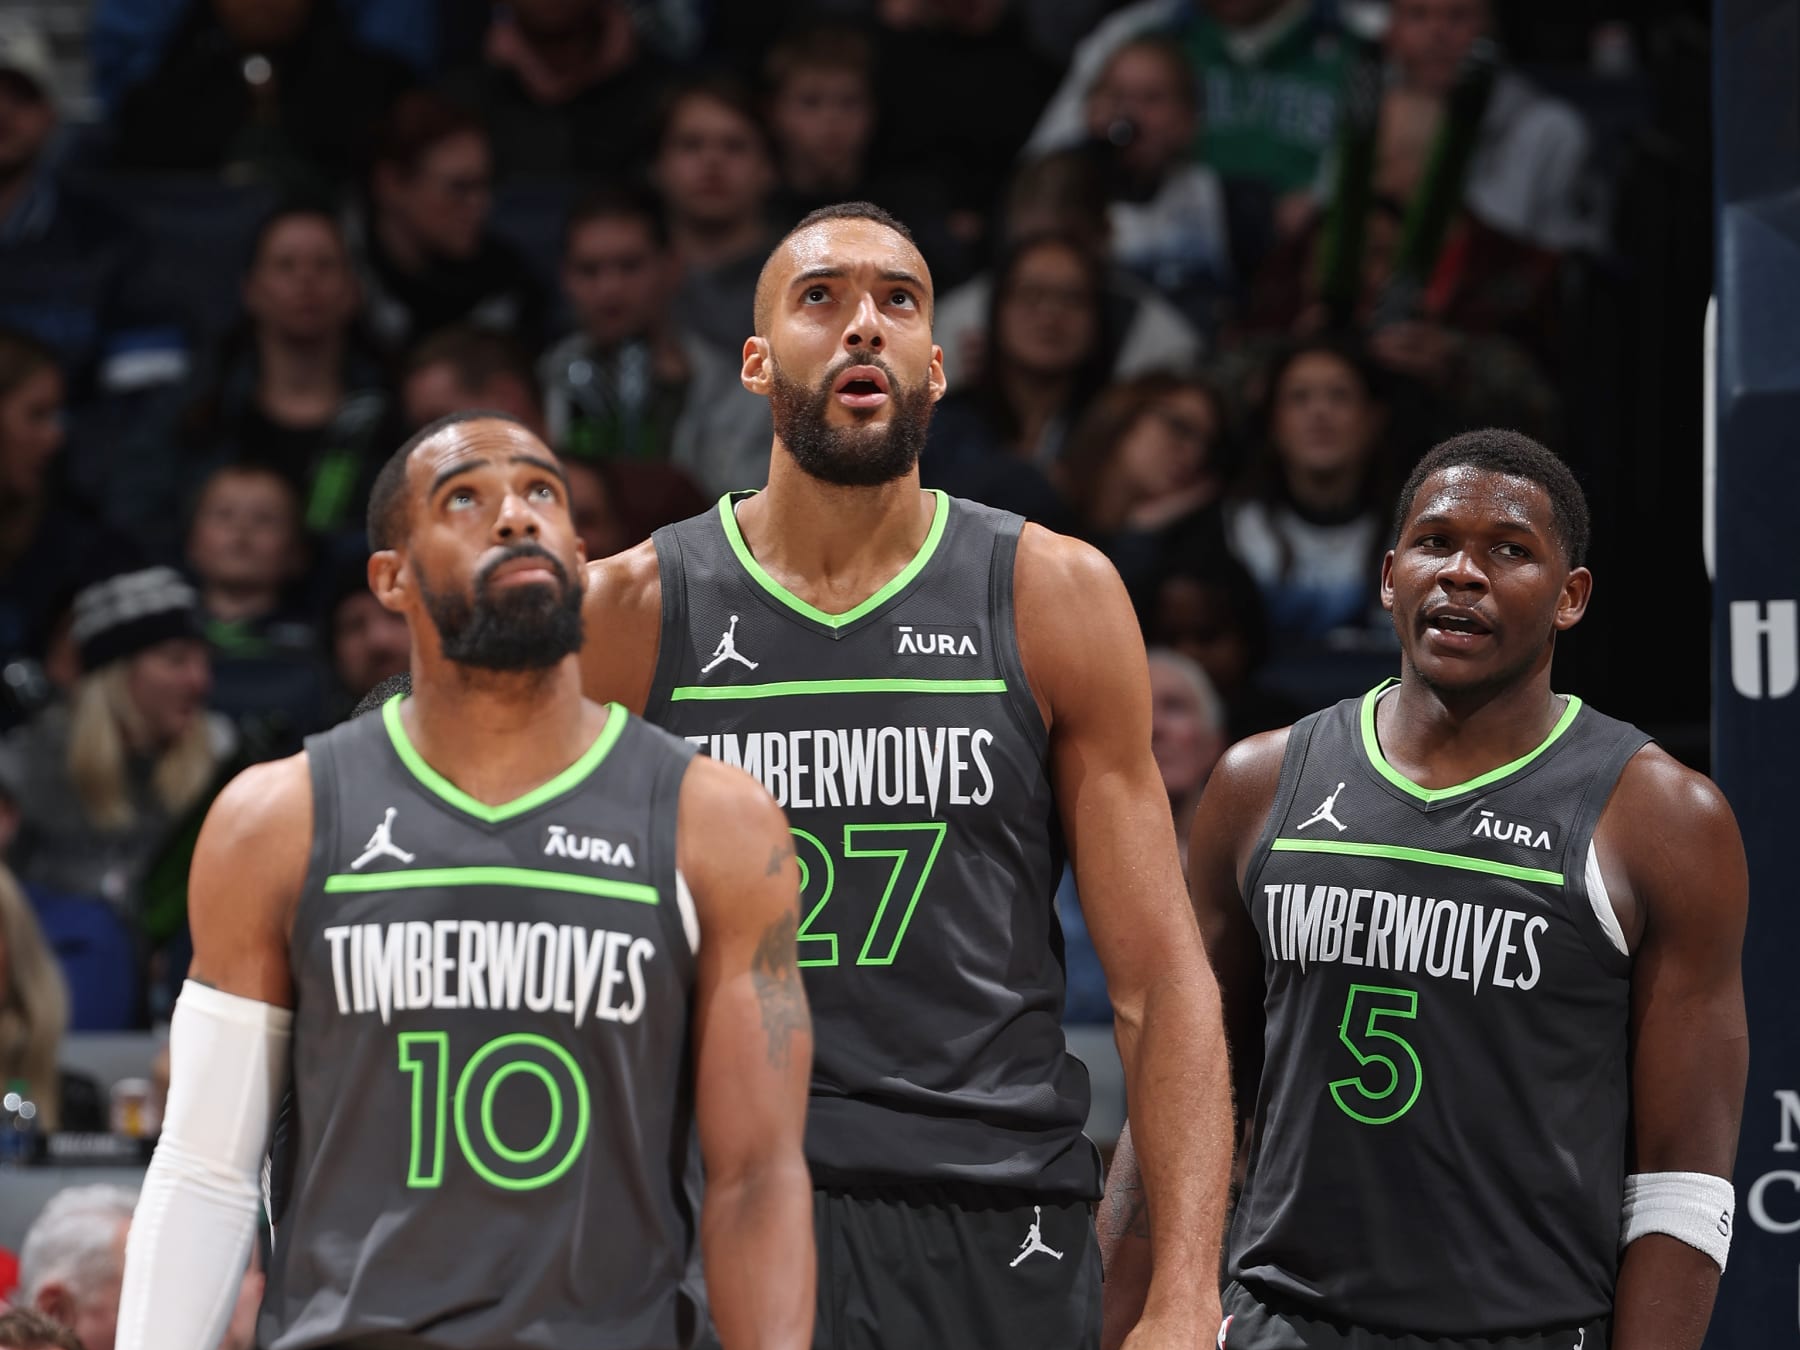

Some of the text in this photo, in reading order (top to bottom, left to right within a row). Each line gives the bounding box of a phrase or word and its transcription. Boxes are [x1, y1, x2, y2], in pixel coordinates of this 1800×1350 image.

[684, 726, 994, 818] BERWOLVES
[795, 823, 947, 967] 27
[1263, 884, 1549, 996] TIMBERWOLVES
[324, 919, 656, 1030] TIMBERWOLVES
[1328, 983, 1423, 1125] 5
[398, 1031, 591, 1191] 10
[1716, 1210, 1731, 1237] 5
